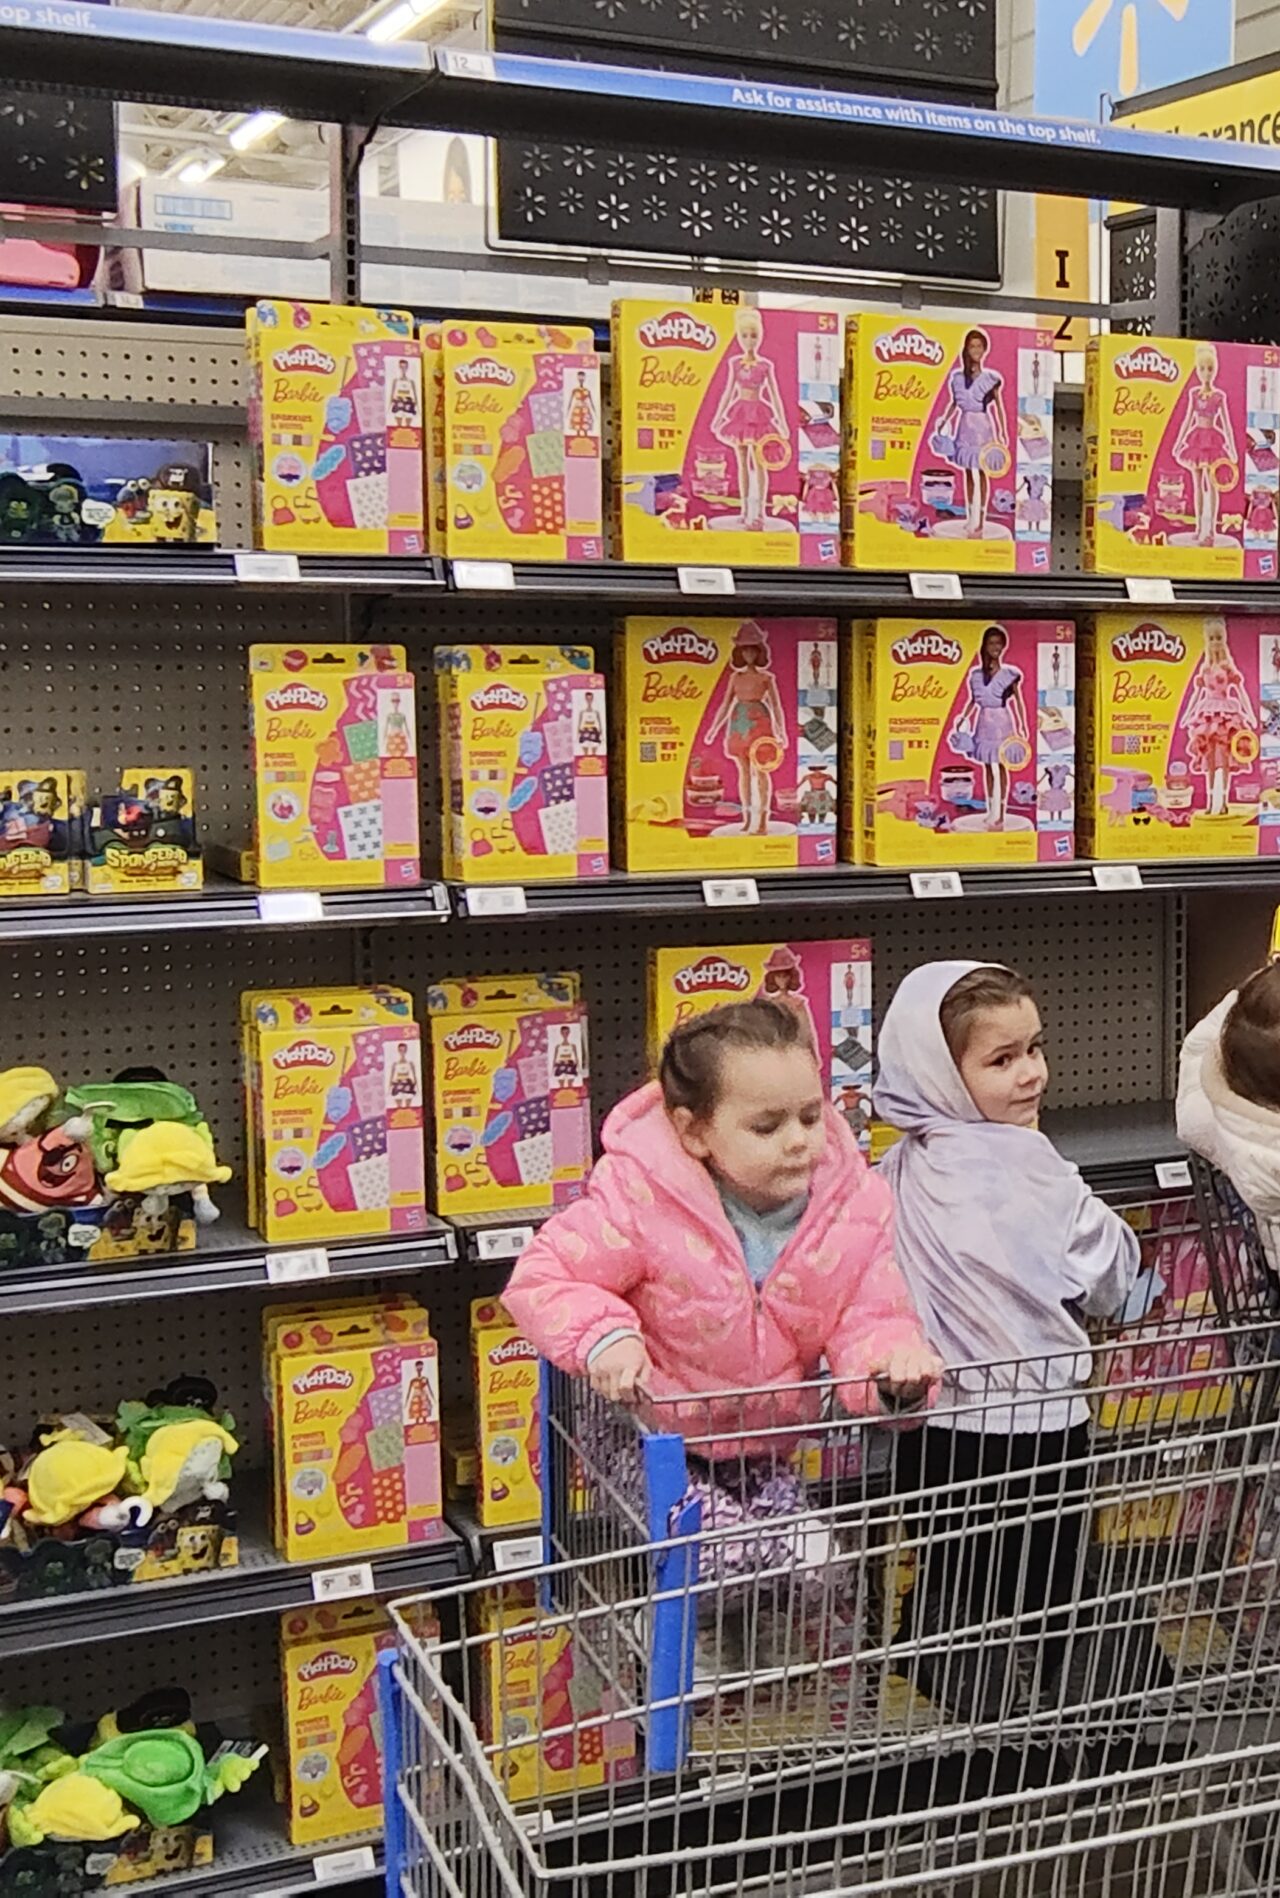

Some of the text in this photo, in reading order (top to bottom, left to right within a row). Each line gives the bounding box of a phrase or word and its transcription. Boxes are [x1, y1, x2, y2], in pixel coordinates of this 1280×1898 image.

[0, 6, 96, 29] op shelf.
[732, 86, 765, 104] Ask
[767, 89, 794, 108] for
[795, 96, 883, 120] assistance
[885, 105, 923, 124] with
[974, 118, 996, 133] on
[997, 119, 1026, 137] the
[1028, 123, 1057, 142] top
[1059, 125, 1100, 145] shelf.
[1055, 250, 1070, 288] I
[640, 318, 716, 349] Play-Doh
[818, 315, 837, 331] 5+
[272, 349, 335, 373] Play-Doh
[874, 334, 945, 364] Play-Doh
[1263, 351, 1280, 364] 5+
[454, 363, 515, 385] Play-Doh
[639, 356, 701, 388] Barbie
[1114, 352, 1179, 382] Play-Doh
[273, 378, 325, 403] Barbie
[873, 370, 931, 401] Barbie
[453, 391, 504, 415] Barbie
[1114, 386, 1166, 416] Barbie
[1055, 625, 1073, 640] 5+
[643, 632, 719, 662] Play-Doh
[891, 632, 962, 663] Play-Doh
[1111, 631, 1186, 662] Play-Doh
[265, 685, 328, 709] Play-Doh
[470, 685, 528, 709] Play-Doh
[643, 671, 704, 703] Barbie
[891, 672, 949, 702] Barbie
[1112, 670, 1172, 703] Barbie
[265, 716, 317, 743] Barbie
[470, 717, 518, 743] Barbie
[850, 943, 869, 959] 5+
[674, 963, 749, 991] Play-Doh
[444, 1026, 502, 1051] Play-Doh
[273, 1043, 335, 1068] Play-Doh
[444, 1058, 490, 1082] Barbie
[274, 1076, 323, 1100] Barbie
[489, 1342, 538, 1364] Play-Do
[293, 1367, 352, 1393] Play-Doh
[489, 1370, 535, 1394] Barbie
[293, 1398, 342, 1425] Barbie
[297, 1655, 356, 1682] Play-Doh
[298, 1684, 346, 1711] Barbie
